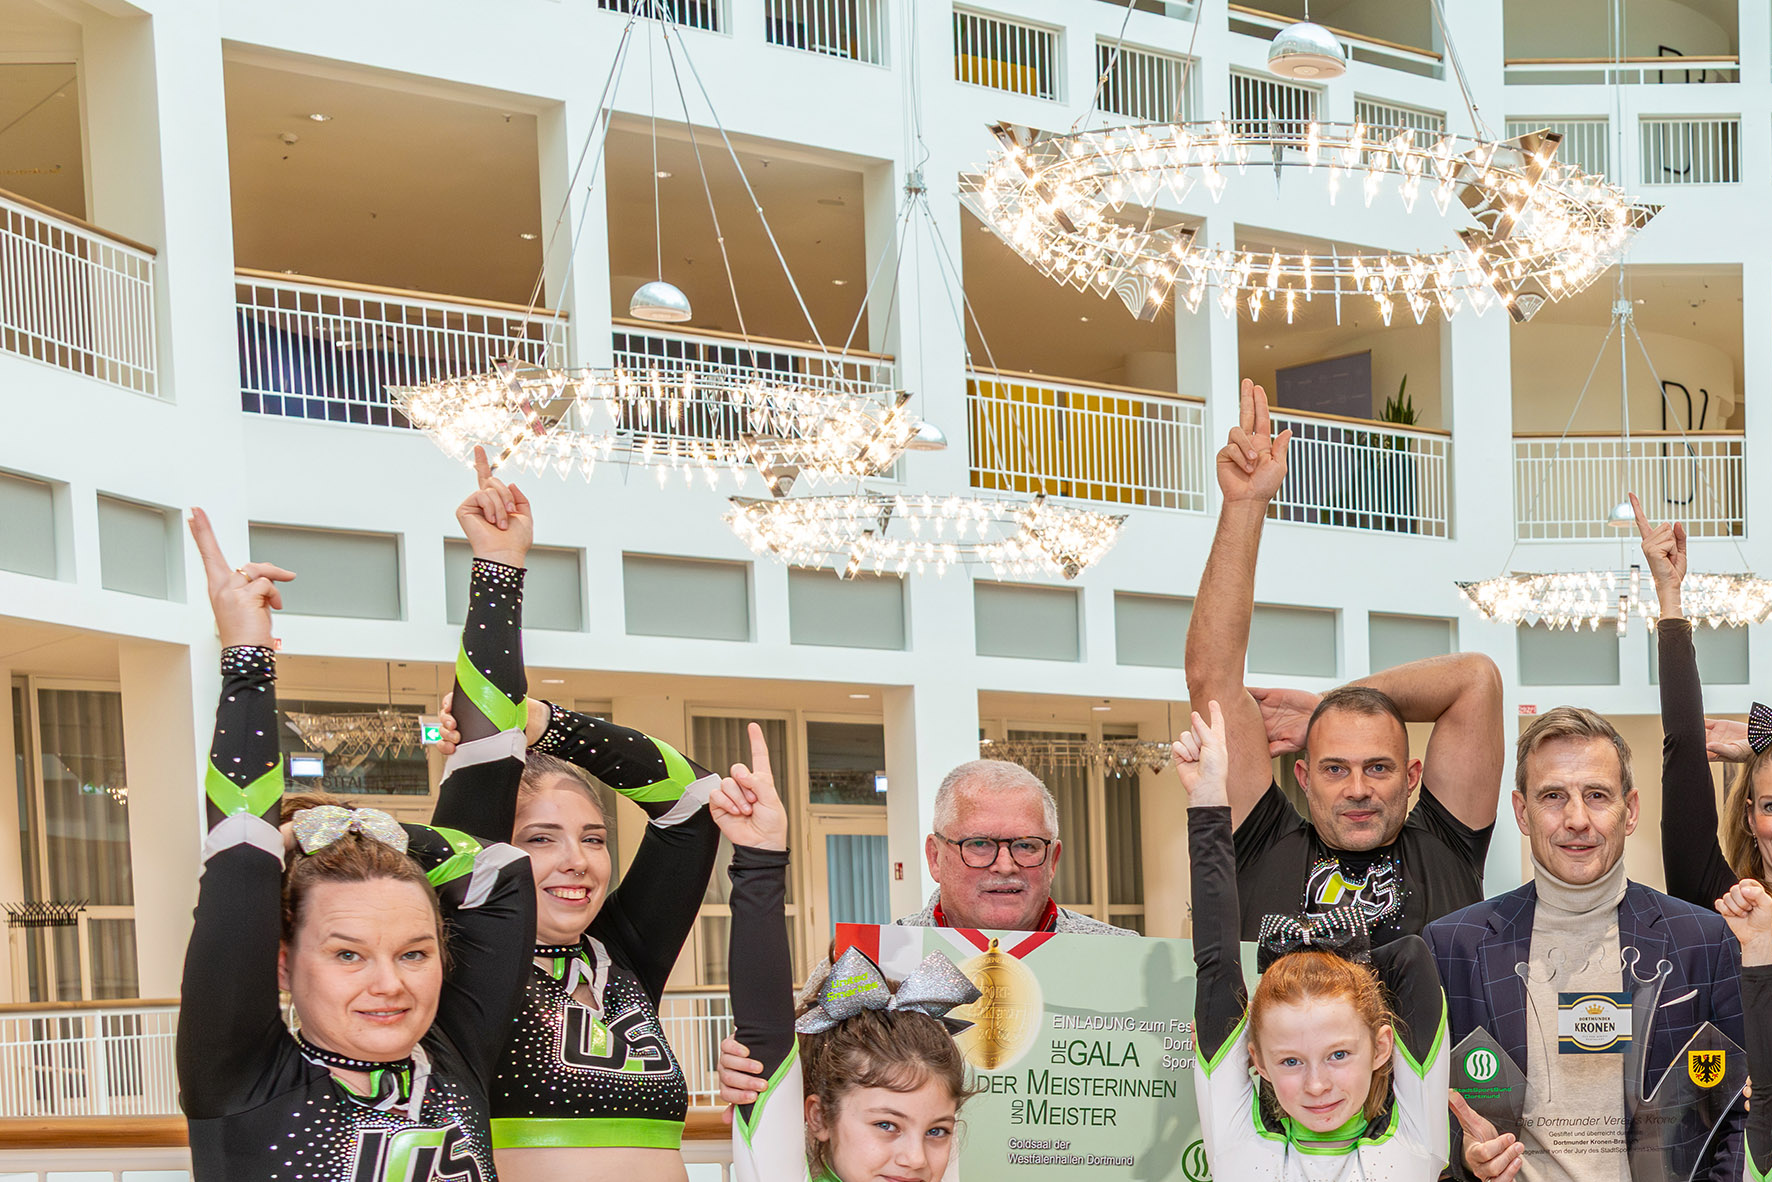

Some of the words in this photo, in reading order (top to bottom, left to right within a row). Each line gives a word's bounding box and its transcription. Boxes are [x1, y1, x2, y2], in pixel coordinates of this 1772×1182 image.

[1052, 1015, 1135, 1031] EINLADUNG
[1139, 1019, 1166, 1033] zum
[1169, 1018, 1193, 1034] Fes
[1574, 1022, 1616, 1033] KRONEN
[1051, 1040, 1067, 1064] DIE
[1067, 1040, 1140, 1067] GALA
[977, 1075, 1017, 1094] DER
[1011, 1099, 1024, 1125] UND
[1515, 1116, 1534, 1127] Die
[1537, 1115, 1601, 1127] Dortmunder
[1604, 1115, 1642, 1126] Veres
[1008, 1138, 1051, 1150] Goldsaal
[1053, 1139, 1070, 1150] der
[1574, 1147, 1587, 1155] Jury
[1008, 1153, 1085, 1165] Westfalenhallen
[1087, 1154, 1134, 1166] Dortmund
